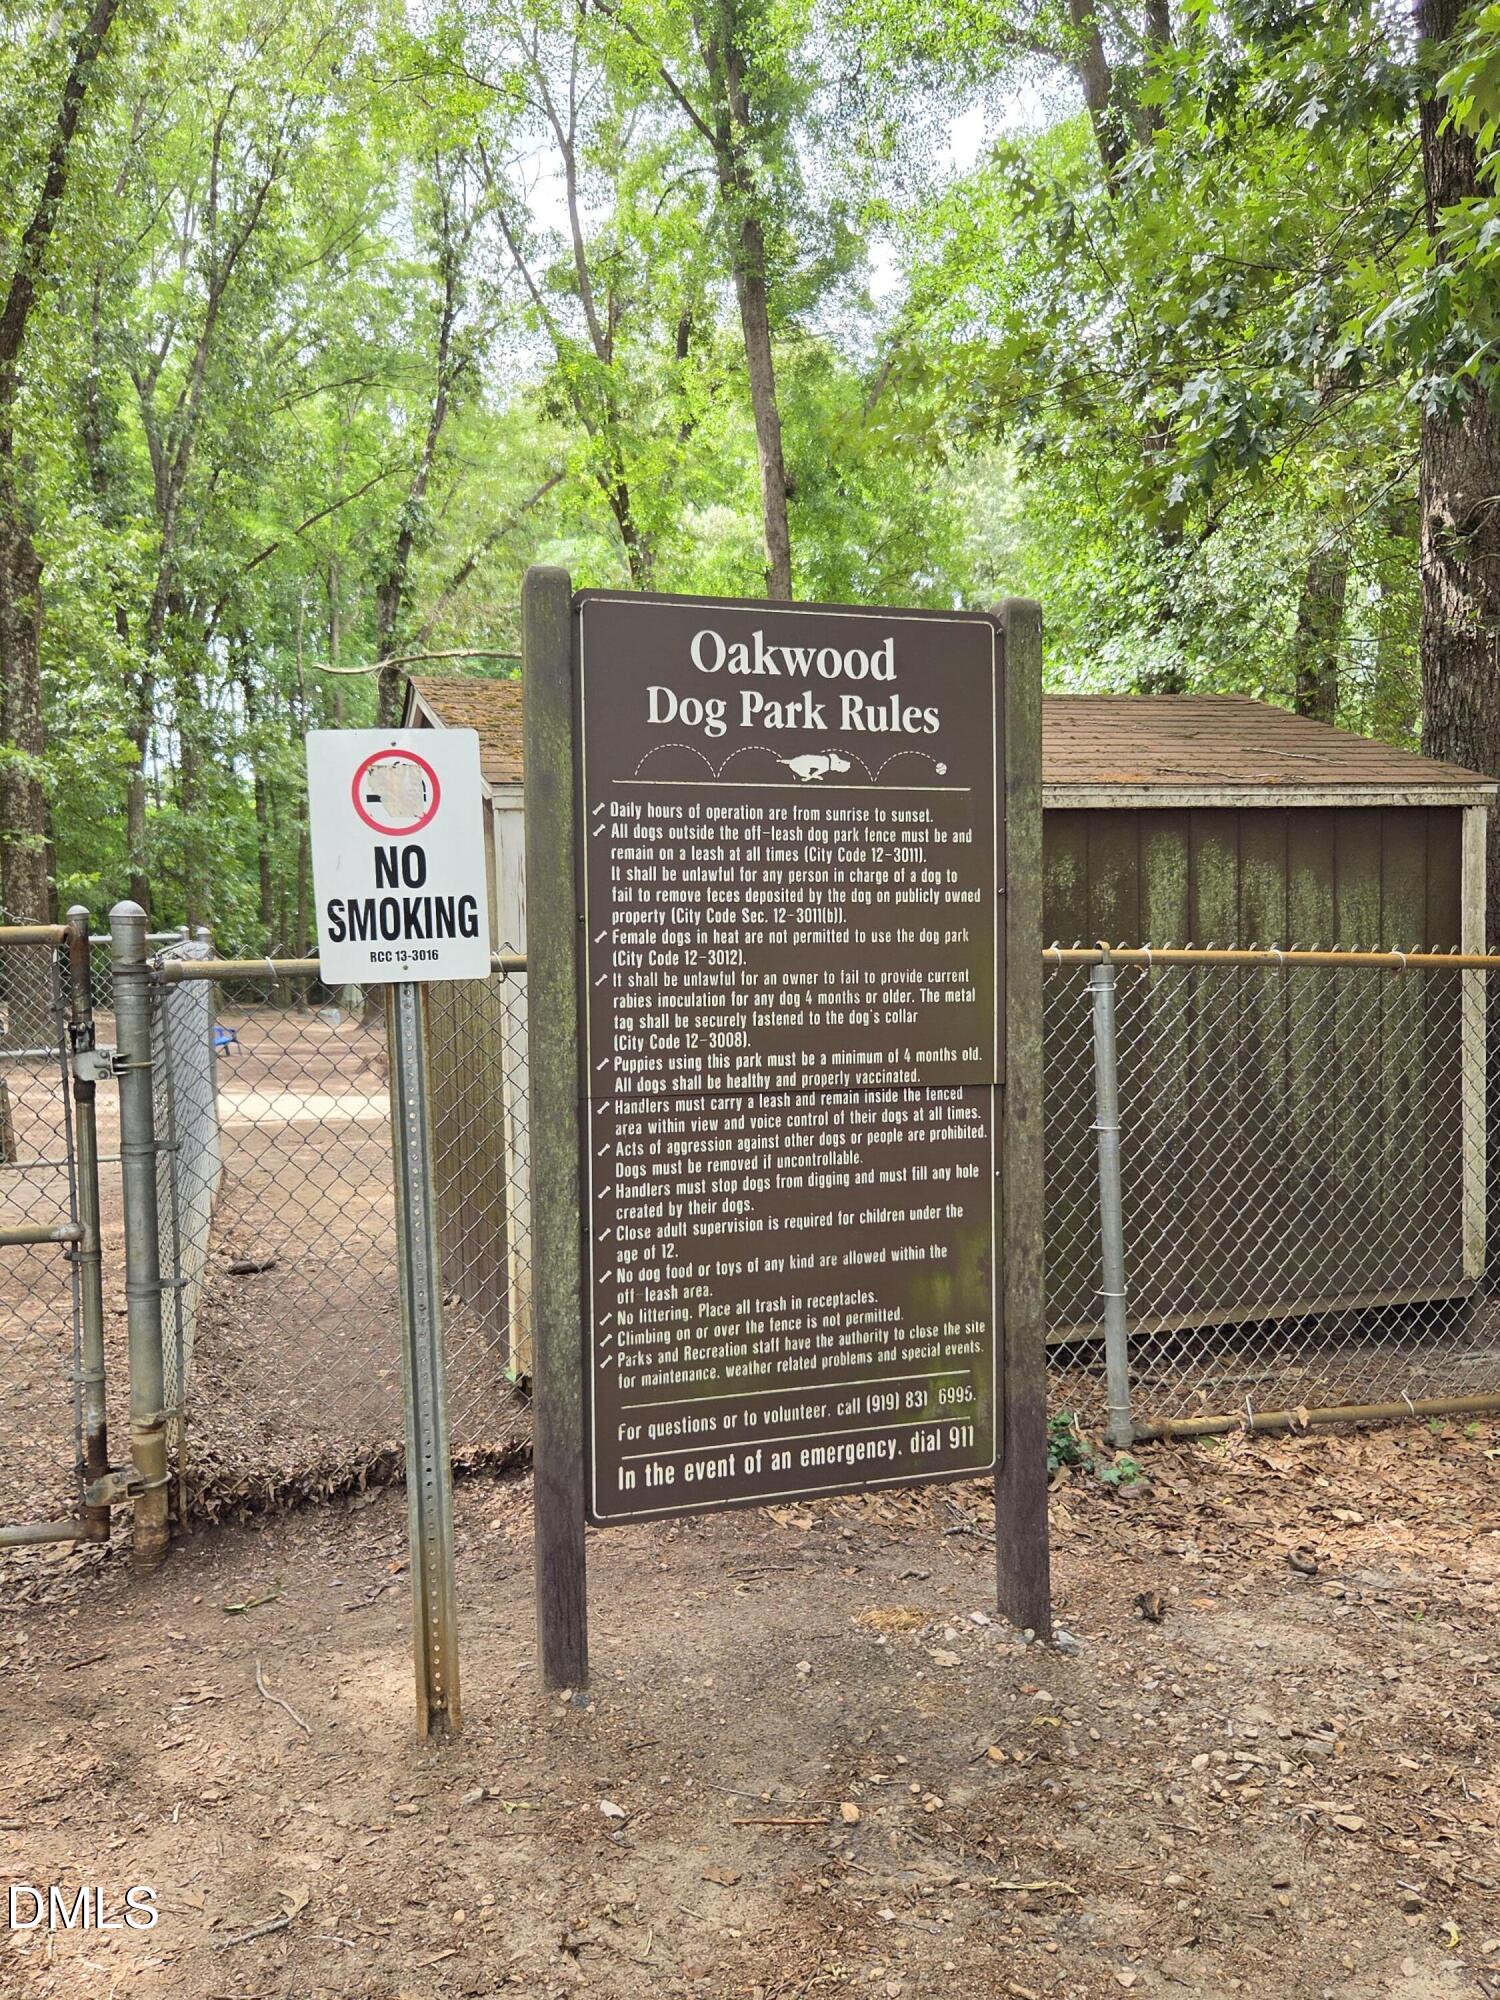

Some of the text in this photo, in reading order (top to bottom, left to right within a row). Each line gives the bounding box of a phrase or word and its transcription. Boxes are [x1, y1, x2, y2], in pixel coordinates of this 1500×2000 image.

[690, 629, 897, 682] Oakwood
[646, 686, 940, 738] Dog Park Rules
[610, 801, 934, 823] Daily hours of operation are from sunrise to sunset.
[611, 822, 972, 844] All dogs outside the off-leash dog park fence must be and
[374, 844, 427, 889] NO
[611, 844, 927, 865] remain on a leash at all times (City Code 12-3011).
[327, 894, 479, 943] SMOKING
[612, 928, 969, 947] Female dogs in heat are not permitted to use the dog park
[370, 949, 439, 963] RCC 13-3016
[613, 948, 747, 969] (City Code 12-3012).
[613, 987, 976, 1009] rabies inoculation for any dog 4 months or older. The metal
[614, 1008, 919, 1032] tag shall be securely fastened to the dog's collar
[614, 1068, 921, 1094] All dogs shall be healthy and properly vaccinated.
[615, 1086, 963, 1115] Handlers must carry a leash and remain inside the fenced
[616, 1124, 988, 1157] Acts of aggression against other dogs or people are prohibited.
[616, 1149, 863, 1179] Dogs must be removed if uncontrollable.
[616, 1163, 979, 1199] Handlers must stop dogs from digging and must fill any hole
[616, 1197, 755, 1220] created by their dogs.
[616, 1243, 679, 1265] age of 12.
[617, 1289, 878, 1326] No littering. Place all trash in receptacles.
[617, 1306, 904, 1347] Climbing on or over the fence is not permitted.
[618, 1466, 636, 1491] In
[645, 1462, 675, 1487] the
[684, 1453, 735, 1482] event
[744, 1449, 762, 1475] of
[771, 1451, 792, 1471] an
[910, 1428, 941, 1454] dial
[949, 1425, 974, 1449] 911
